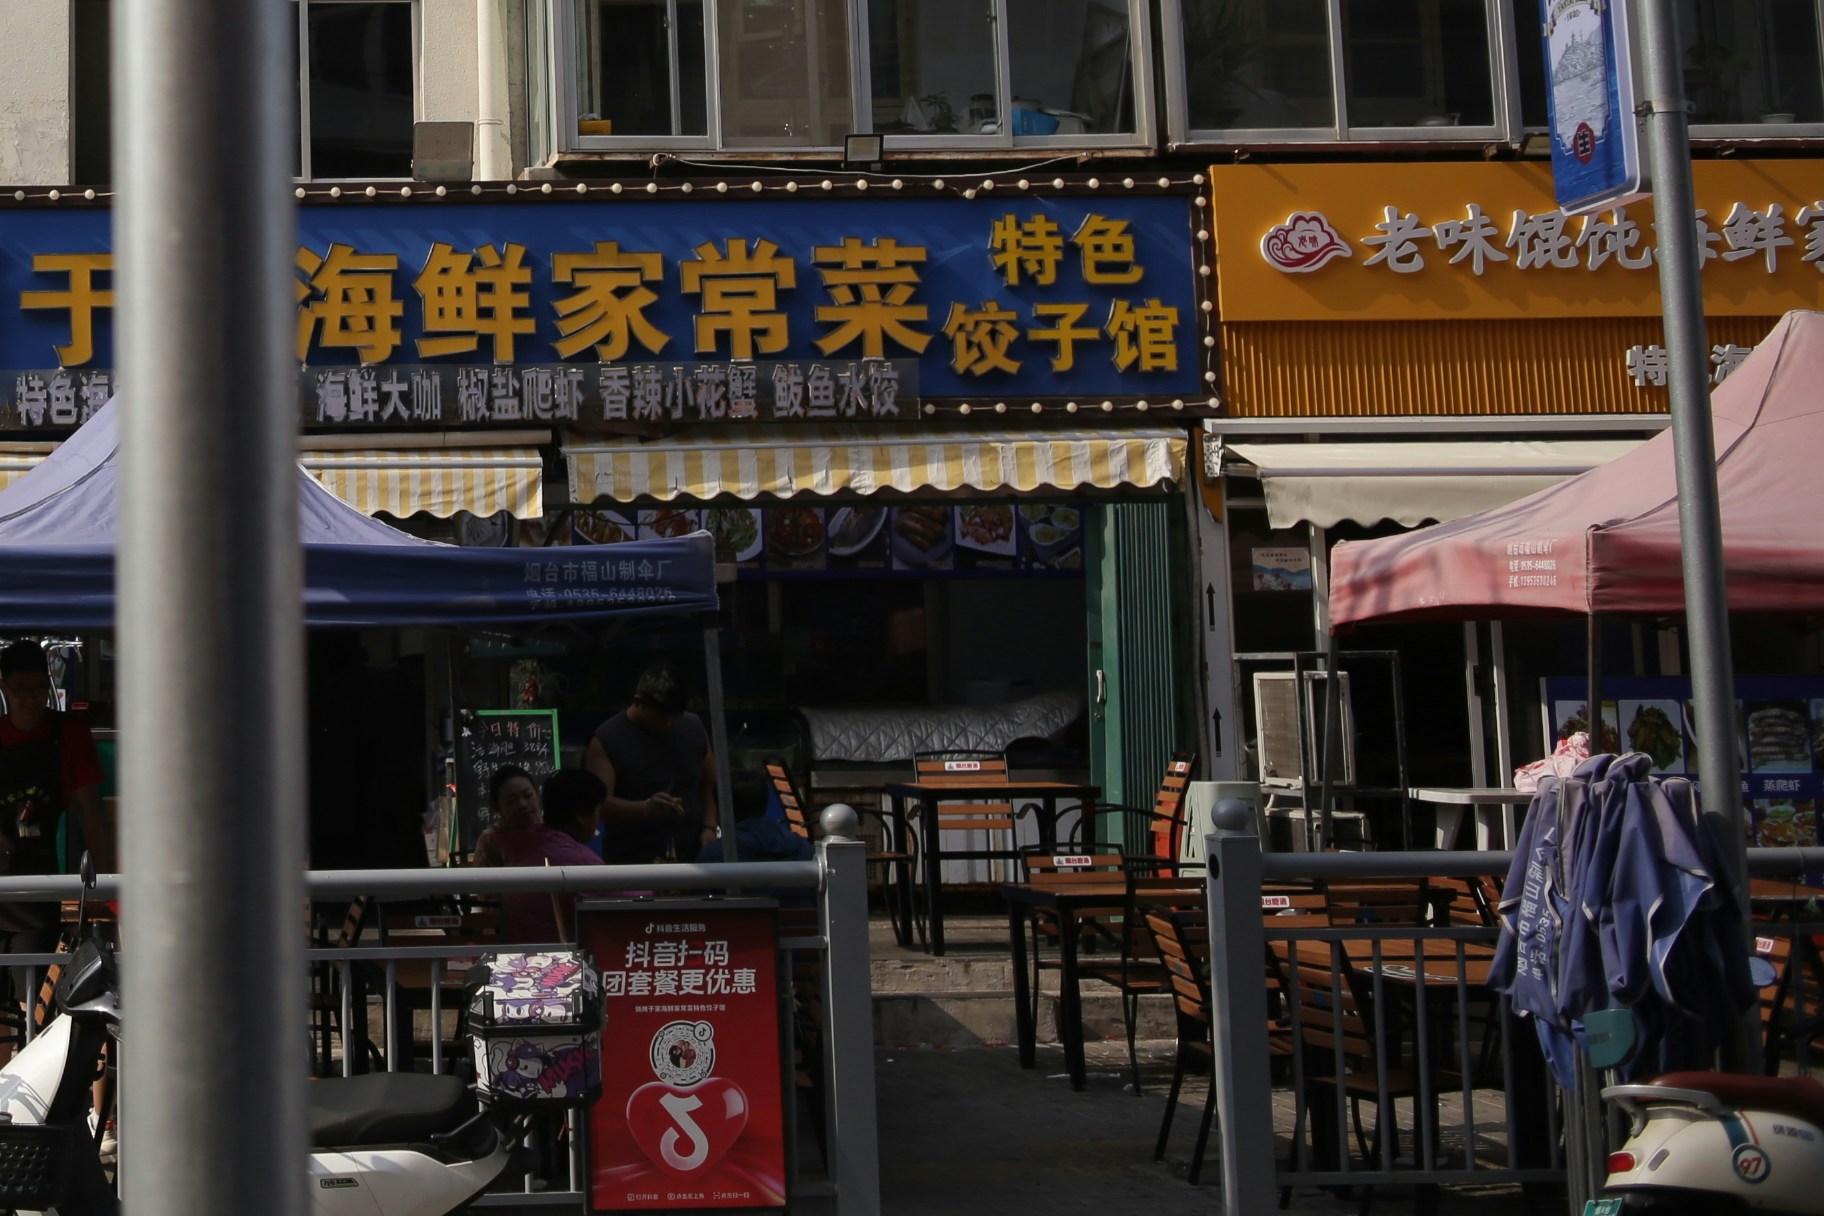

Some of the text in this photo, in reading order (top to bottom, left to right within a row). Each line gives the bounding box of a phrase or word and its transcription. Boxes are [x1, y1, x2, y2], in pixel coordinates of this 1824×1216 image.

[988, 213, 1147, 287] 特色
[942, 297, 1180, 376] 饺子馆
[315, 367, 444, 424] 海鲜大咖
[457, 367, 586, 423] 椒盐爬虾
[599, 365, 759, 421] 香辣小花蟹
[771, 362, 901, 419] 鲅鱼水饺
[523, 559, 673, 584] 烟台市福山制伞厂
[1763, 779, 1801, 792] 蒸爬虾
[1262, 898, 1288, 906] 台啤酒
[625, 939, 729, 968] 抖音扫码
[602, 967, 757, 997] 团套餐更优惠
[1739, 1157, 1763, 1176] 97
